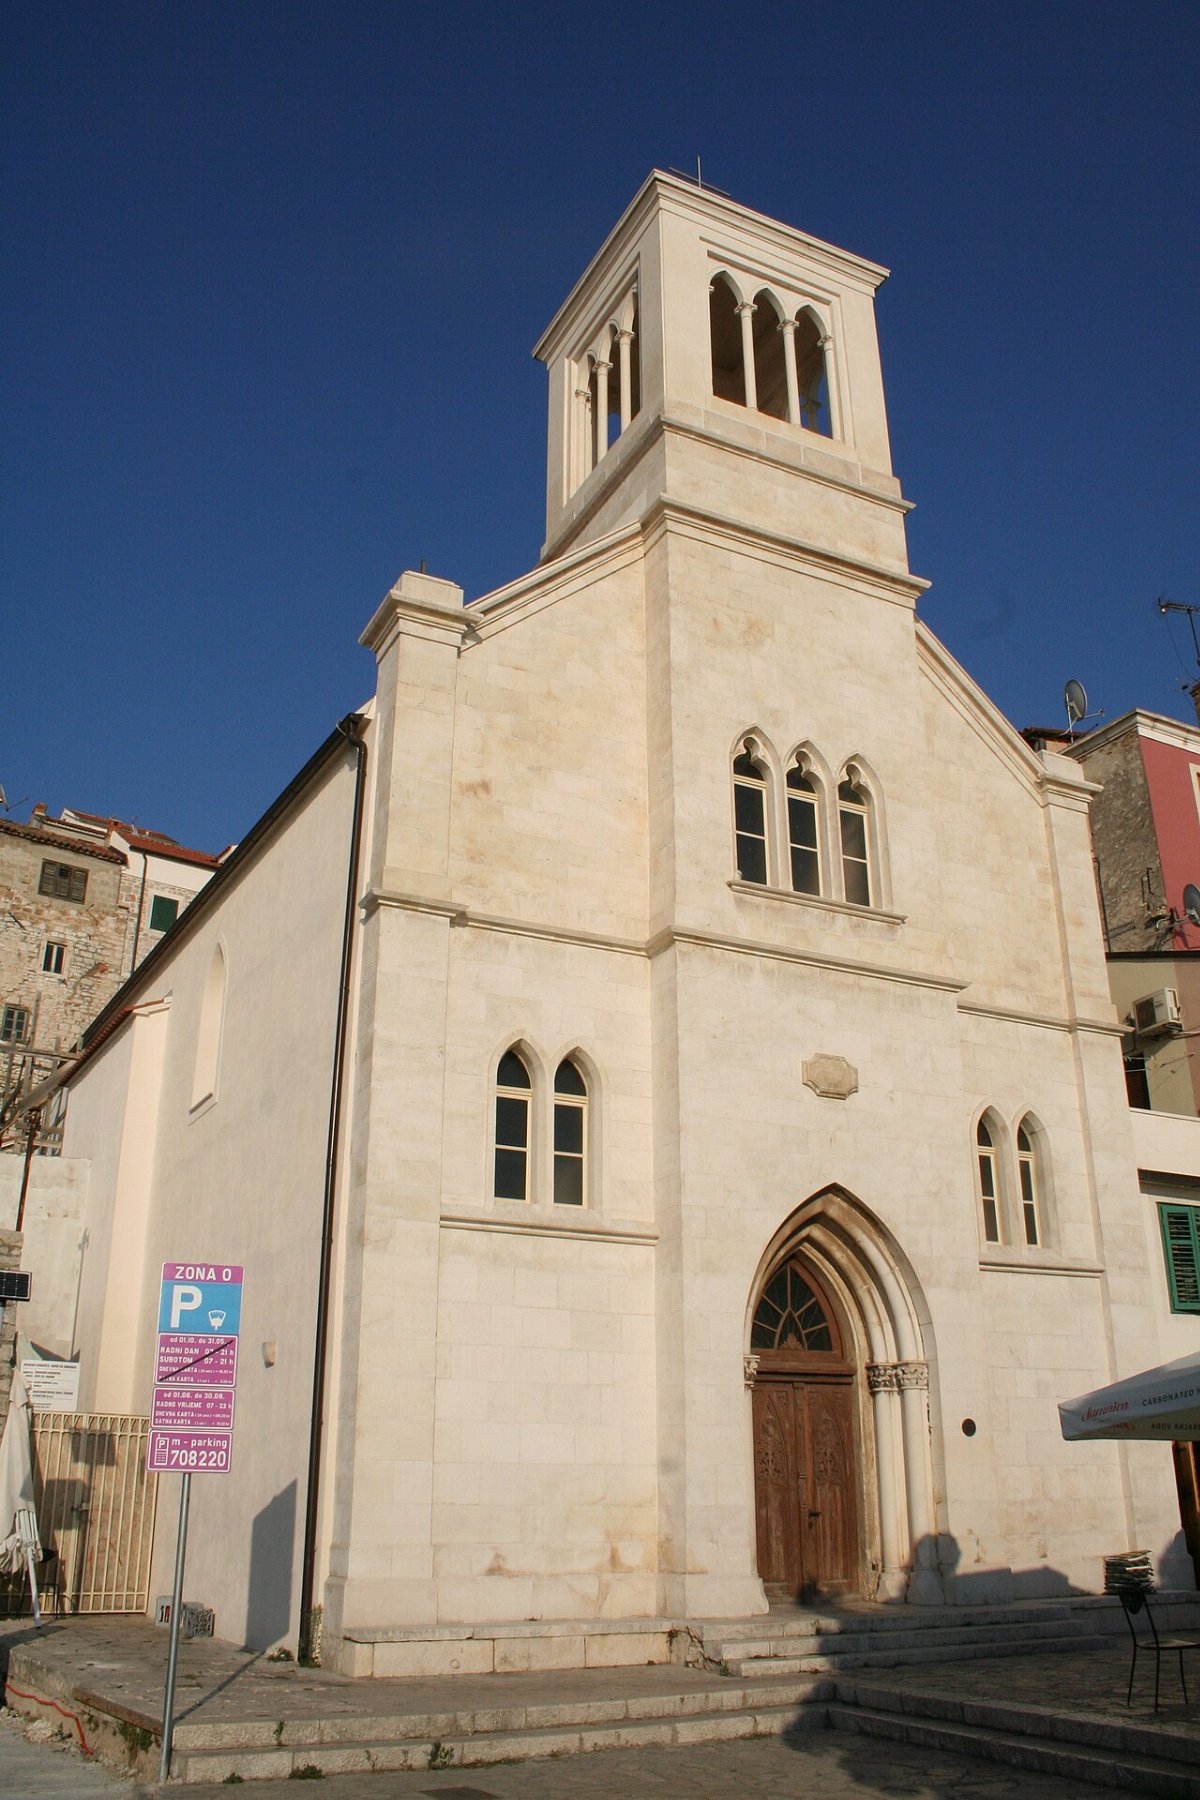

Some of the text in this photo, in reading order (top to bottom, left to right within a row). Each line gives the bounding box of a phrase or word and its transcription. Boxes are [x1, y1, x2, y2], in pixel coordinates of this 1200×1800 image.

[175, 1266, 216, 1280] ZONA
[170, 1285, 202, 1328] P
[1143, 1388, 1194, 1406] CARBONATED
[191, 1438, 227, 1449] parking
[170, 1450, 226, 1467] 708220
